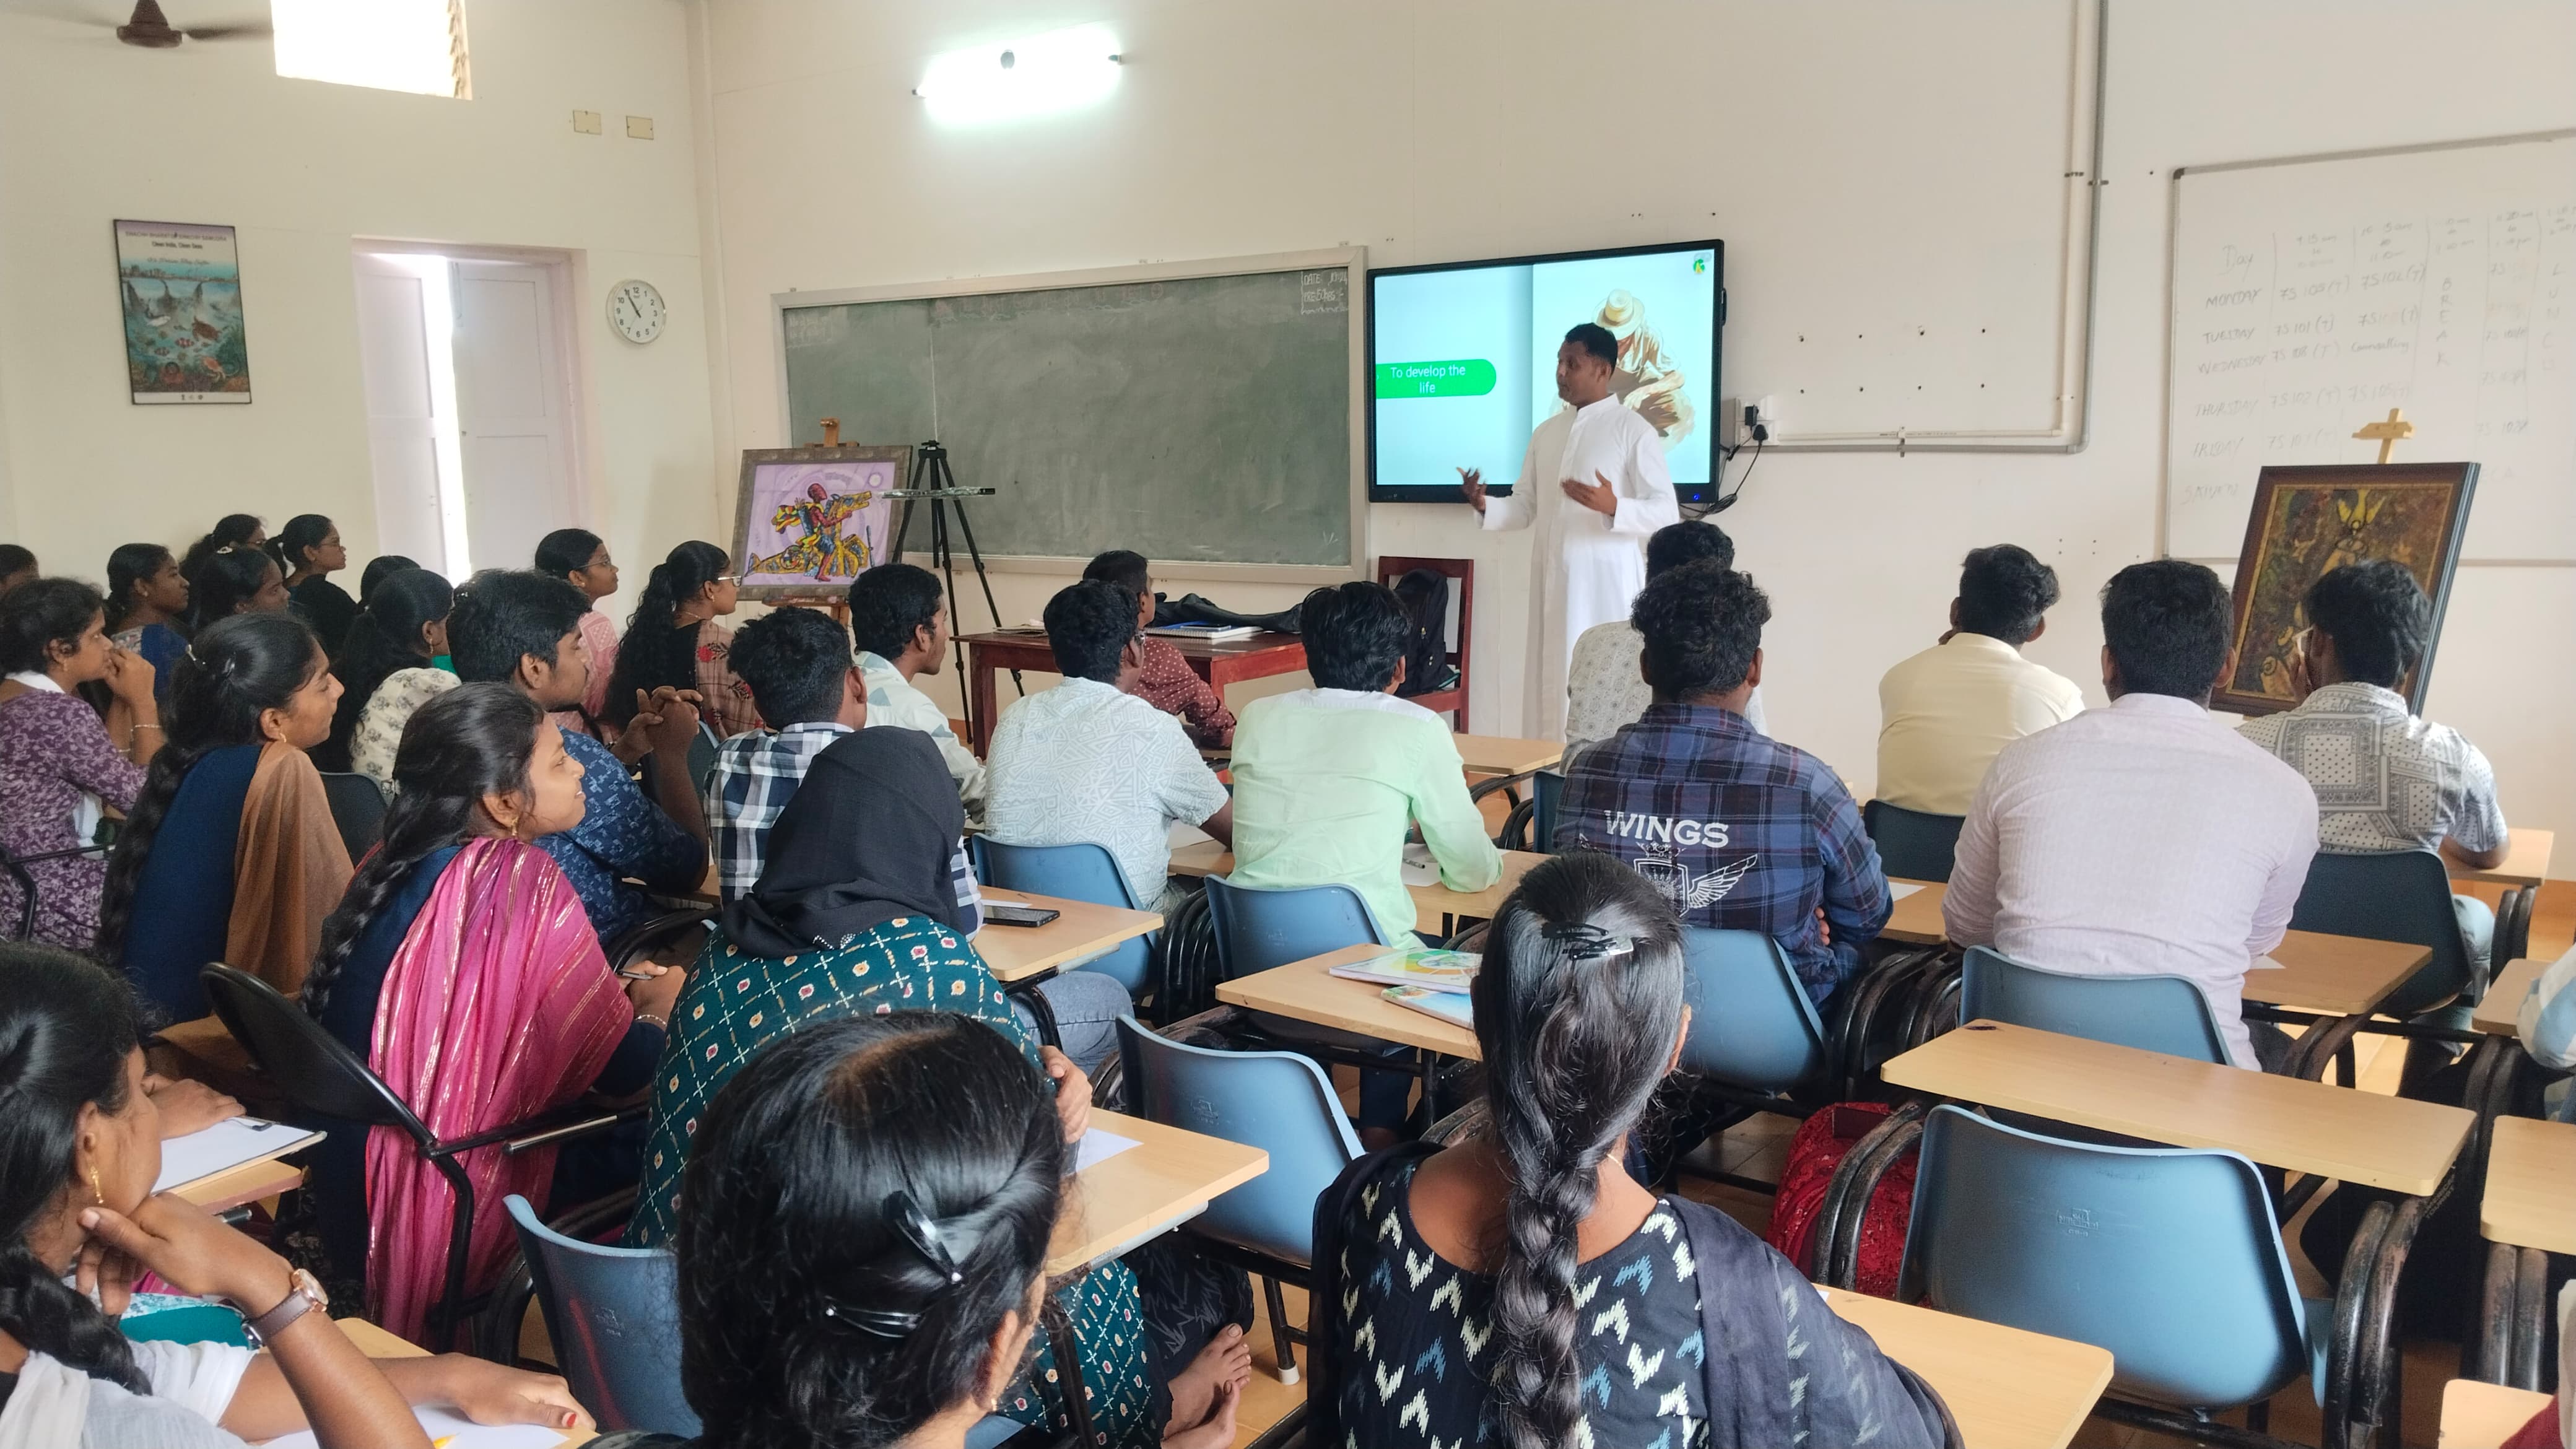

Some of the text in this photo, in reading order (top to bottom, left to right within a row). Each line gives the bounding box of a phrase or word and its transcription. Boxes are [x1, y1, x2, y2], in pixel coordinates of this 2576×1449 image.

[2206, 287, 2263, 309] MONDAY
[2203, 327, 2256, 344] TUESDAY
[1390, 363, 1466, 380] To develop the
[2198, 354, 2266, 374] WEDNESDAY
[1419, 381, 1435, 394] life
[2195, 398, 2259, 417] THURSDAY
[1604, 810, 1729, 848] WINGS
